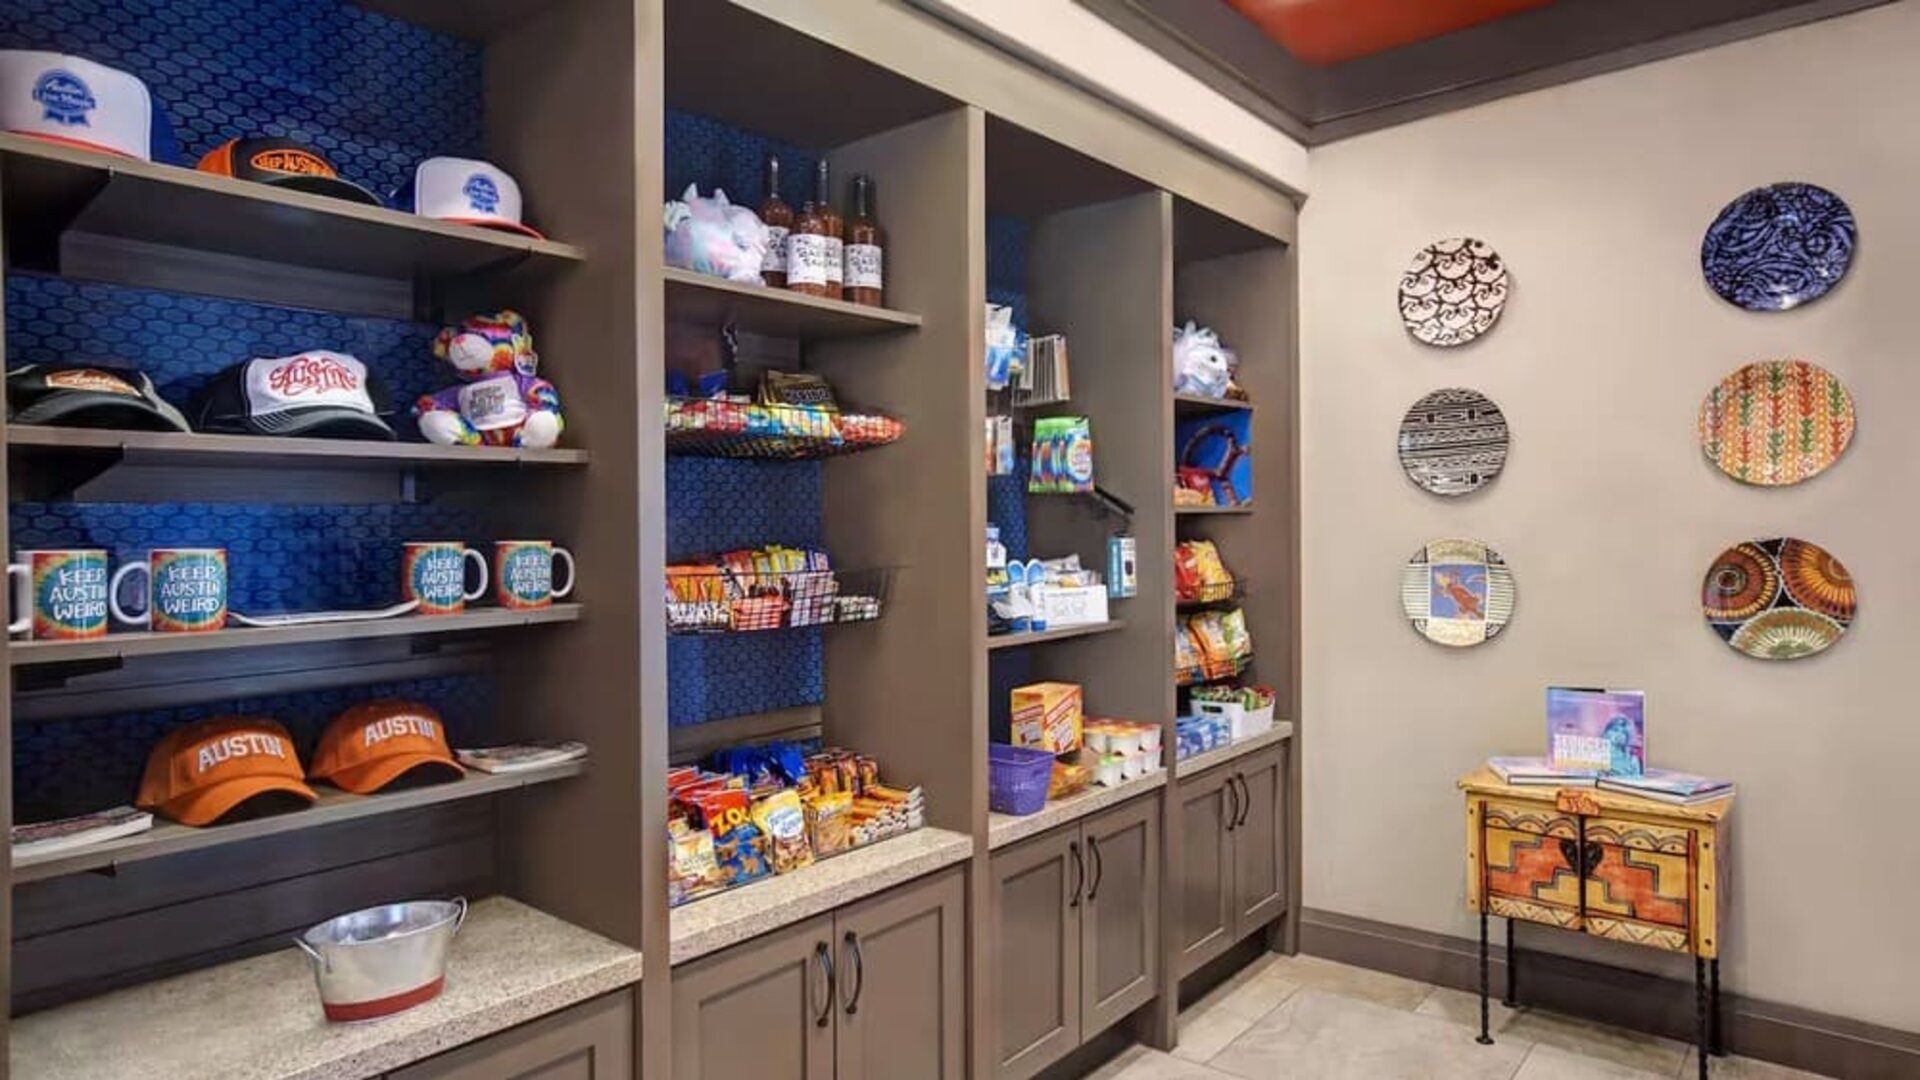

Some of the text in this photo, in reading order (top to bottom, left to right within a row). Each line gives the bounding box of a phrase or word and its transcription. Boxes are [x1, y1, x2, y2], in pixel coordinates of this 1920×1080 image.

[426, 556, 461, 571] KEEP
[59, 567, 106, 586] KEEP
[168, 566, 216, 582] KEEP
[160, 581, 220, 598] AUSTIN
[53, 600, 107, 621] WEIRD
[163, 597, 219, 615] WEIRD
[363, 714, 436, 748] AUSTIN
[198, 732, 285, 773] AUSTIN
